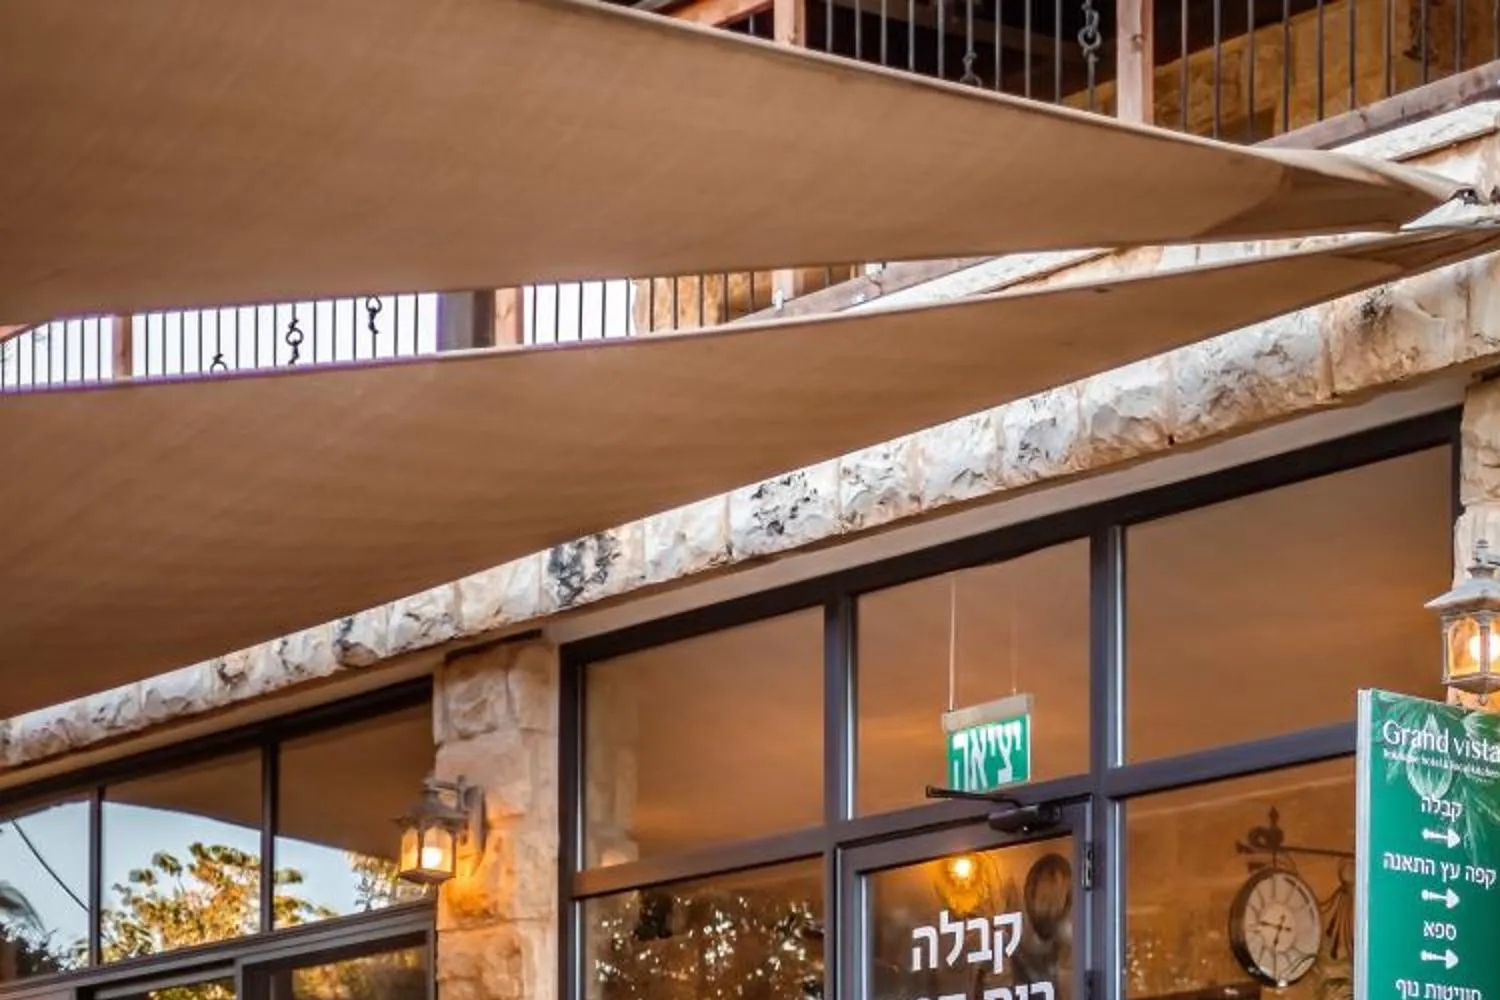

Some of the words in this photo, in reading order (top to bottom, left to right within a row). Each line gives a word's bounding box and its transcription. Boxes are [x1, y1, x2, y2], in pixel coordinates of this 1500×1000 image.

[1383, 719, 1449, 754] Grand
[1453, 732, 1500, 763] vista
[952, 719, 1022, 792] יציאה
[1420, 797, 1463, 822] קבלה
[1383, 851, 1435, 876] התאנה
[1440, 861, 1461, 884] עץ
[1465, 864, 1497, 889] קפה
[911, 910, 1023, 974] קבלה
[1423, 920, 1457, 941] ספא
[1395, 979, 1420, 1000] נוף
